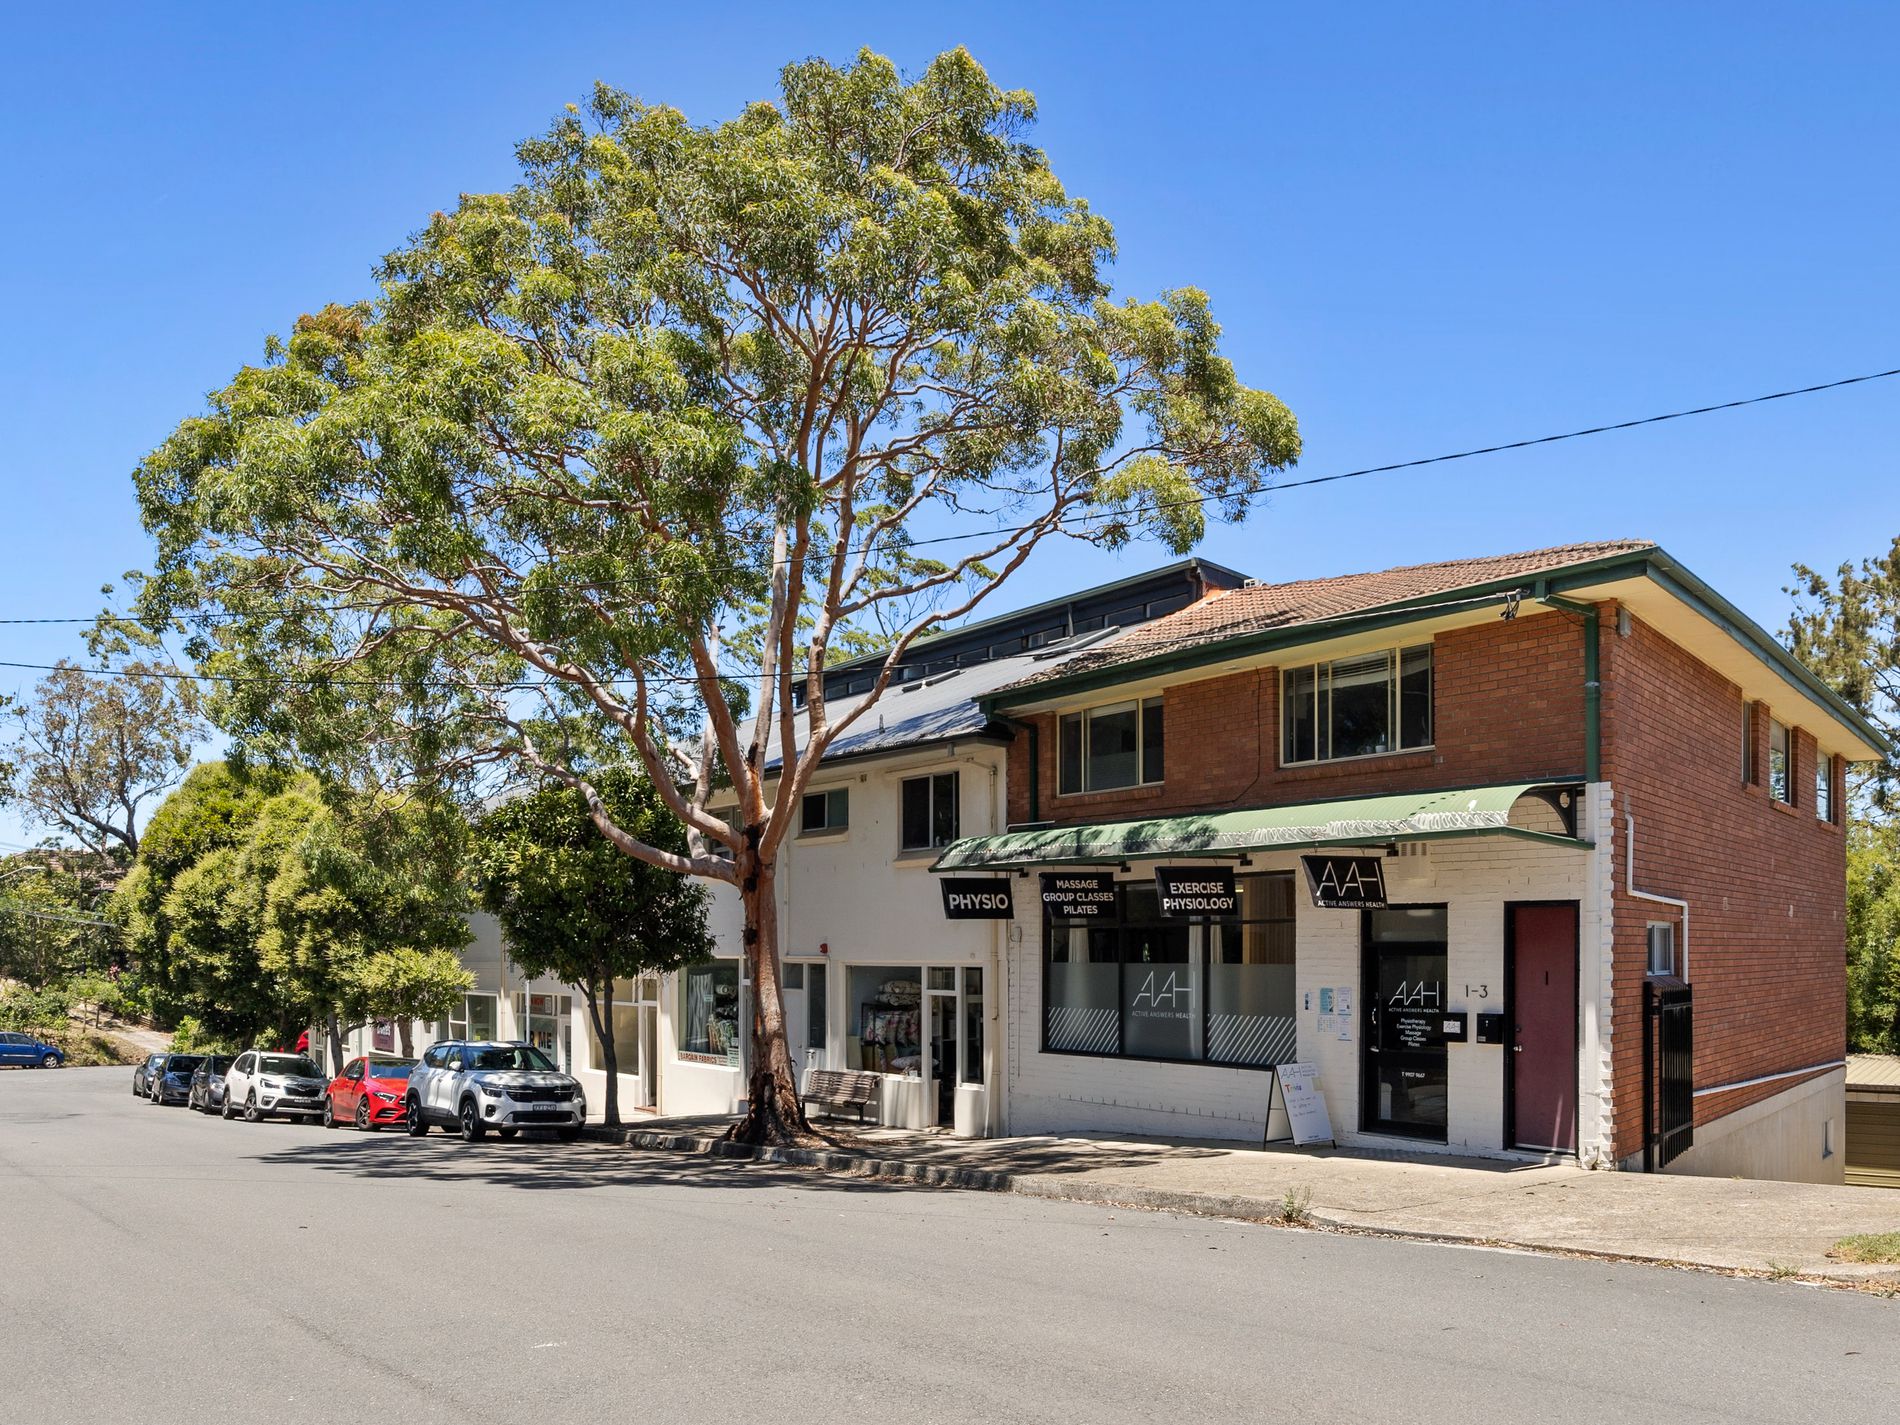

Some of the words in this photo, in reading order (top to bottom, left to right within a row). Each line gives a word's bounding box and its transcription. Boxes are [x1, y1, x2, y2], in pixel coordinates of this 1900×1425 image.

[1056, 879, 1098, 889] MASSAGE
[1170, 882, 1224, 894] EXERCISE
[949, 894, 1009, 910] PHYSIO
[1043, 892, 1075, 902] GROUP
[1076, 892, 1114, 902] CLASSES
[1063, 905, 1098, 915] PILATES
[1163, 898, 1234, 910] PHYSIOLOGY
[1338, 900, 1365, 908] ANSWERS
[1465, 985, 1488, 998] 1-3
[680, 1052, 698, 1061] BARGAIN
[699, 1055, 717, 1064] FABRICS
